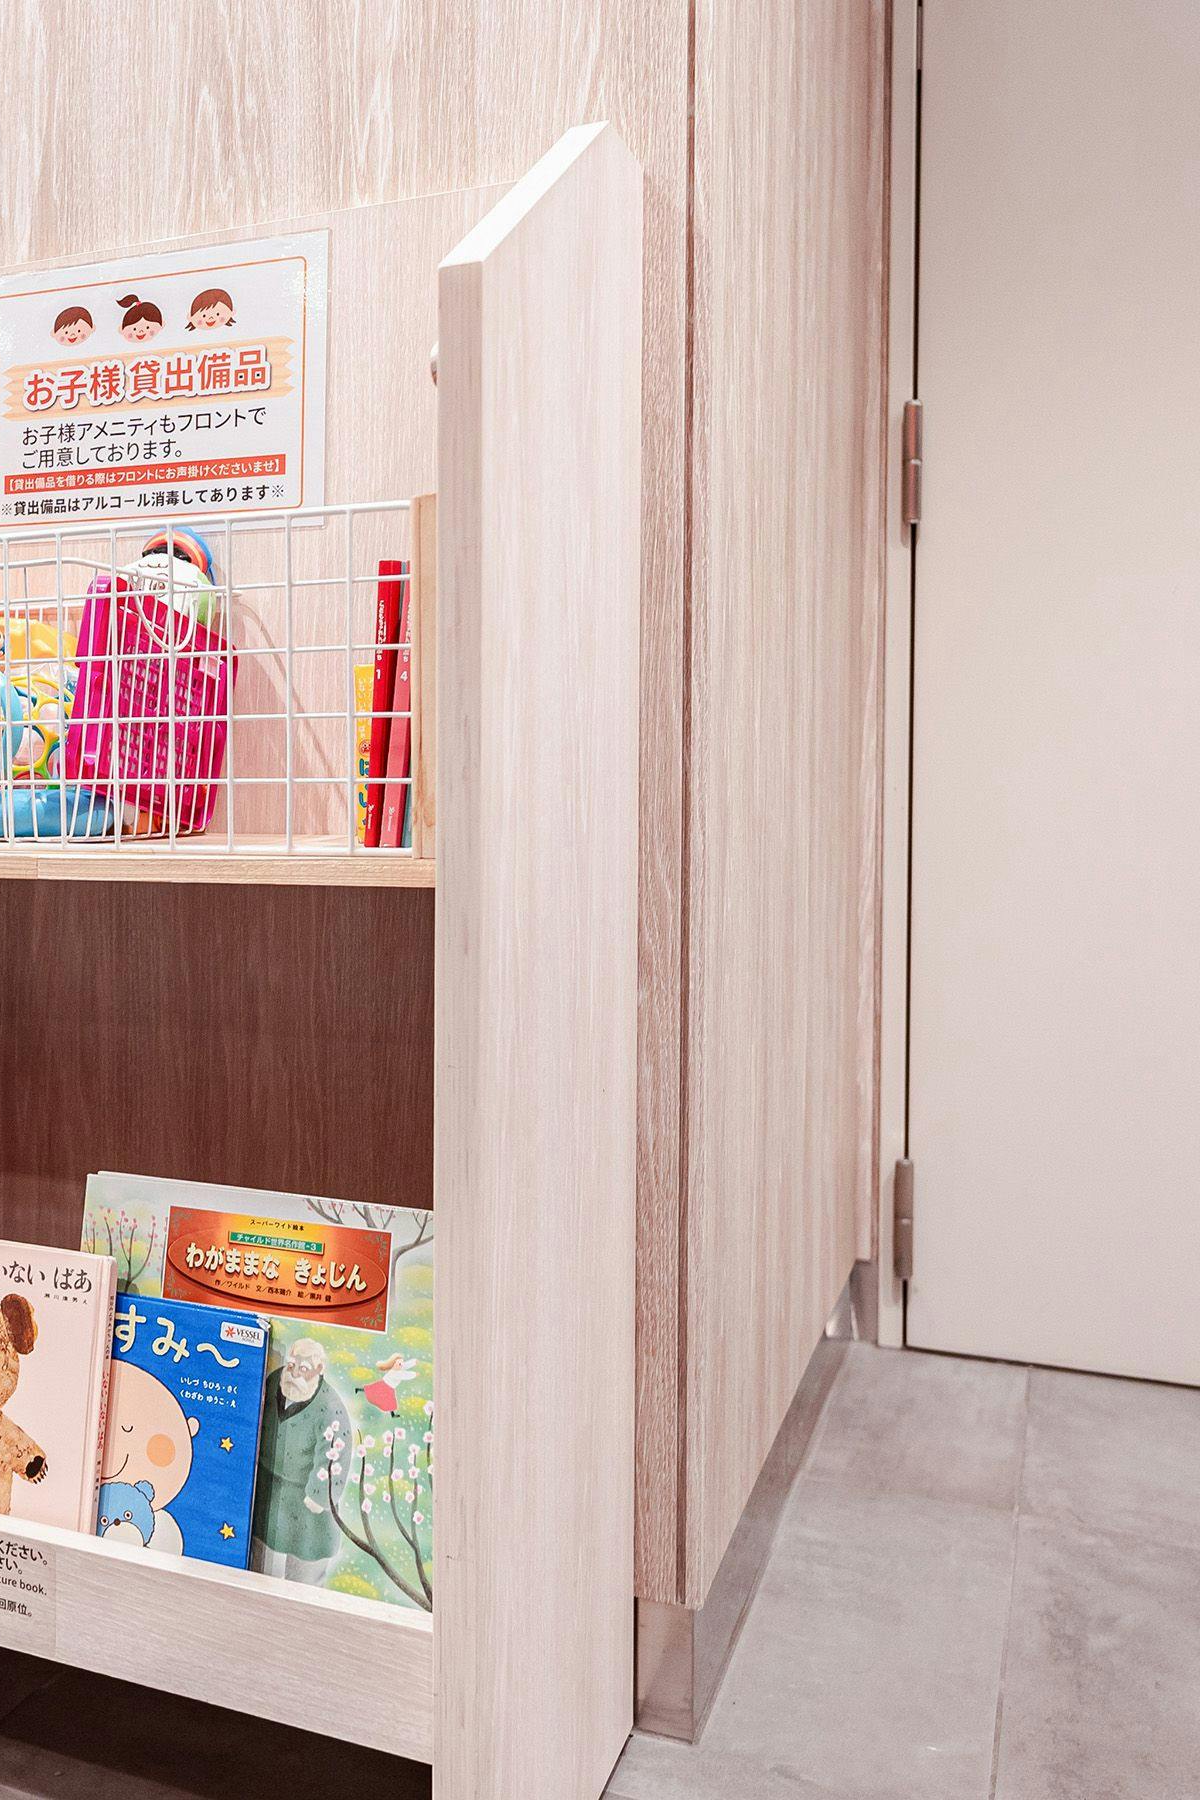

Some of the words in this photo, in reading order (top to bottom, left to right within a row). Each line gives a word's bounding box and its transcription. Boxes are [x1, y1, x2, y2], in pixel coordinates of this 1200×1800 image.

[26, 349, 267, 407] お子様貸出備品
[22, 407, 267, 446] お子様アメニティもフロントで
[22, 438, 183, 470] ご用意しております。
[7, 458, 282, 492] 【貸出備品を借りる際はフロントにお声掛けくださいませ】
[1, 484, 285, 516] ※貸出備品はアルコール消毒してあります※
[400, 670, 408, 682] 4
[250, 1219, 305, 1232] スーパーワイド絵本
[53, 1266, 93, 1294] ばあ
[186, 1242, 281, 1281] わがままな
[294, 1256, 368, 1293] きょじん
[236, 1327, 261, 1340] VESSEL
[19, 1581, 48, 1596] book.
